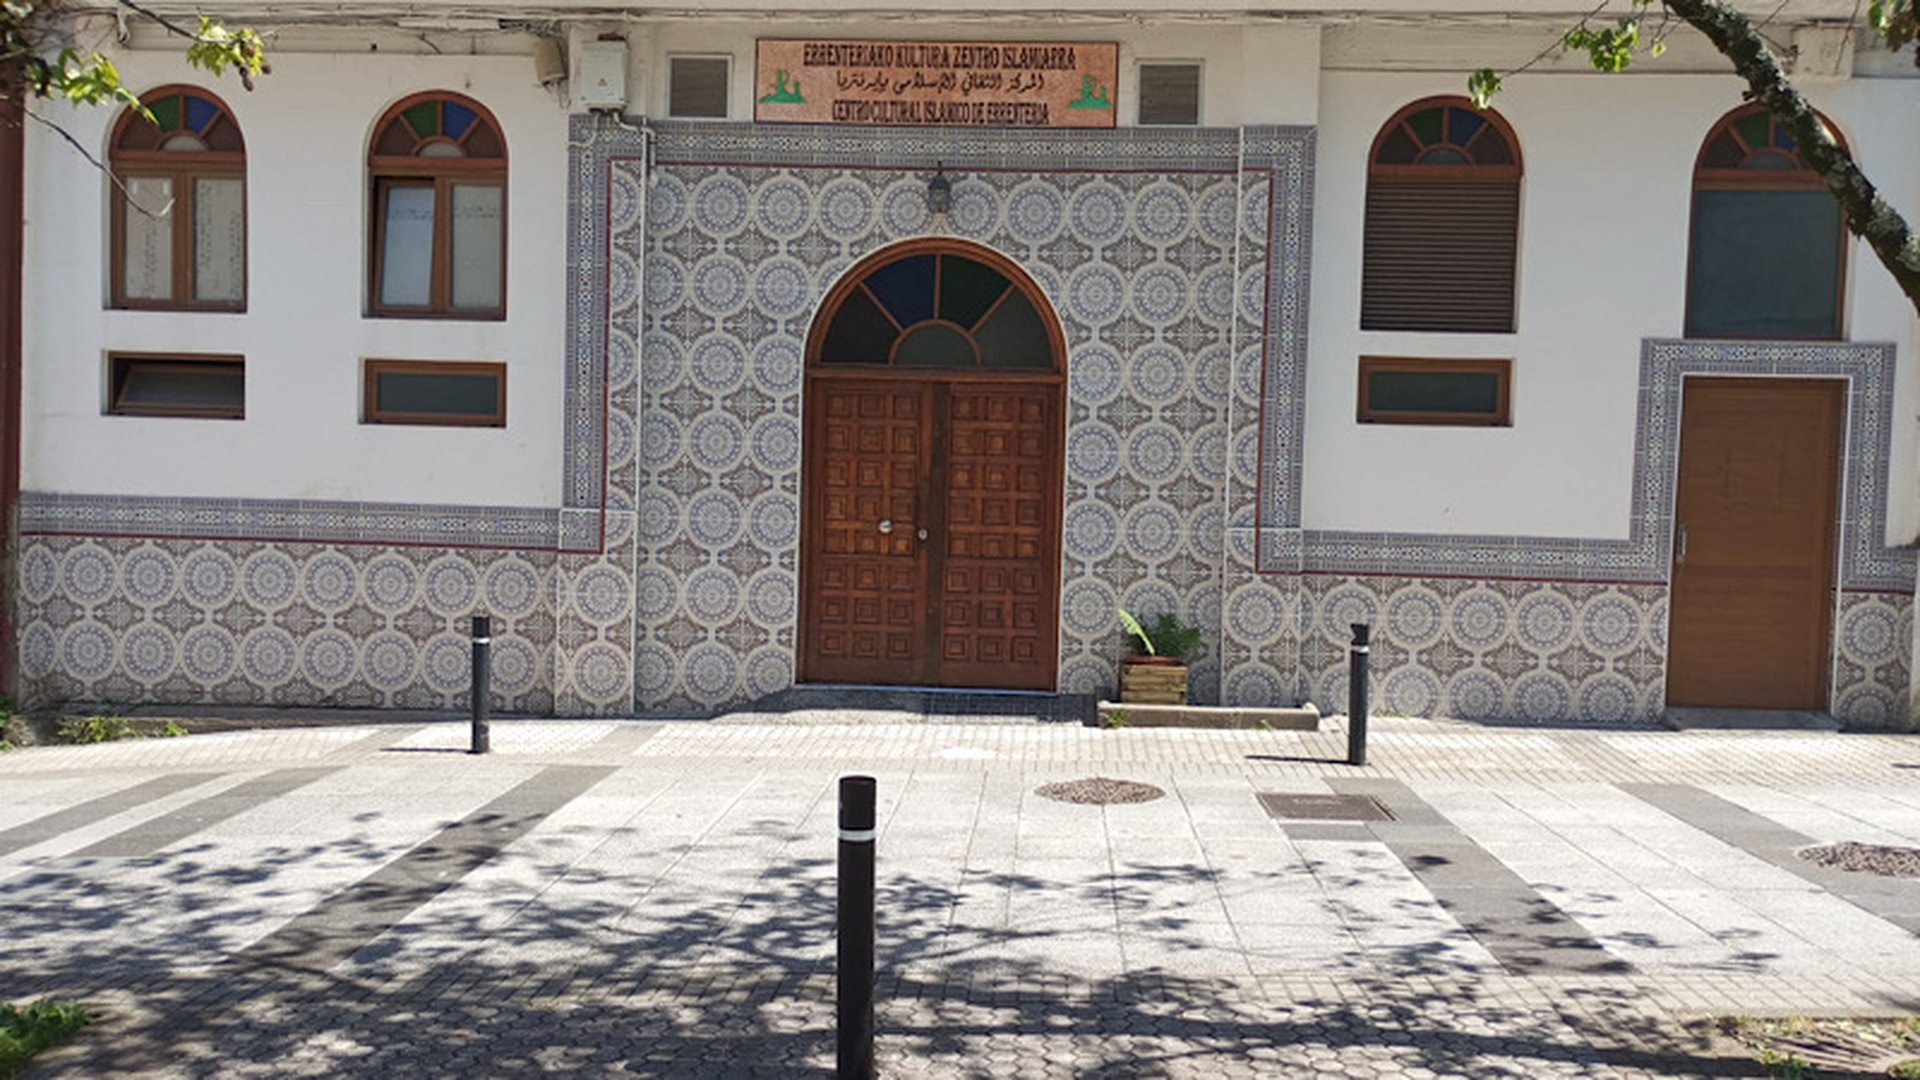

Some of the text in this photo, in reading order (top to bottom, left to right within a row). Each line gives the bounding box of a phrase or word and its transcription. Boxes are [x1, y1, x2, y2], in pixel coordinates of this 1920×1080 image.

[803, 43, 894, 67] ERRENTERIAKO
[895, 45, 950, 68] KULTURA
[952, 45, 1000, 69] ZENTRO
[1004, 72, 1045, 93] المركز
[832, 99, 873, 121] CENTRO
[873, 100, 922, 123] CULTURAL
[971, 101, 985, 123] DE
[987, 101, 1049, 125] ERRENTERIA
